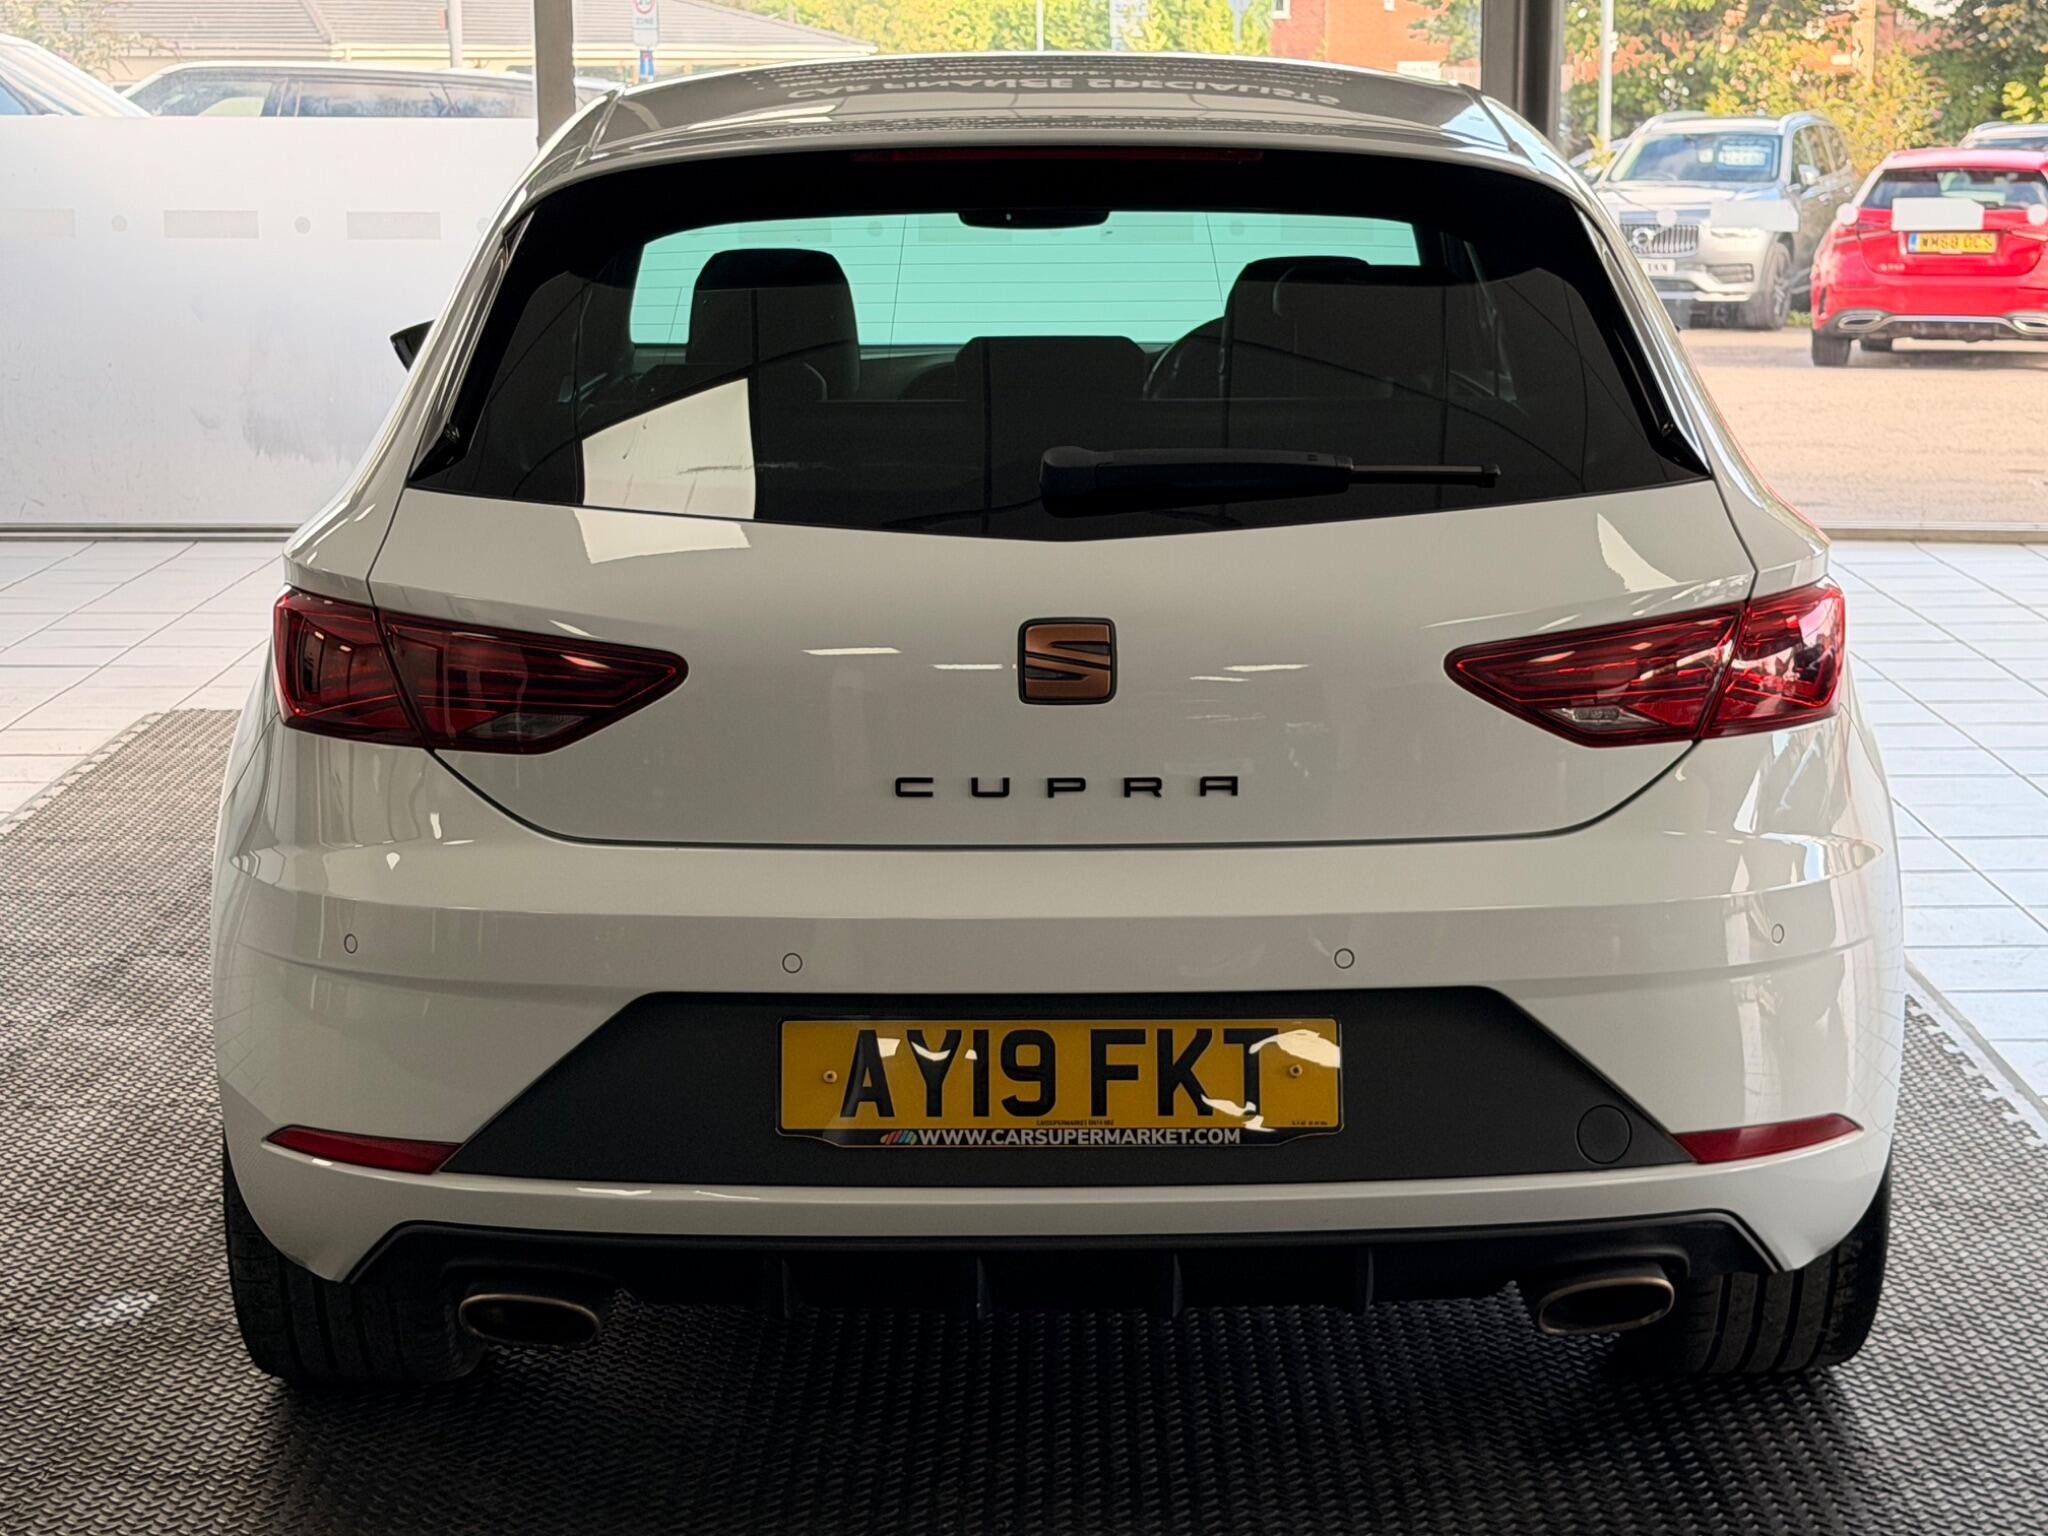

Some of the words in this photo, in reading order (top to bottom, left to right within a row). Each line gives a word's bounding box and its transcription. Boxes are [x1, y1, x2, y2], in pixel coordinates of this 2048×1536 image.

[895, 776, 1239, 798] CUPRA
[840, 1029, 1056, 1118] AY19
[1090, 1028, 1279, 1117] FKT
[918, 1128, 1241, 1145] WWW.CARSUPERMARKET.COM
